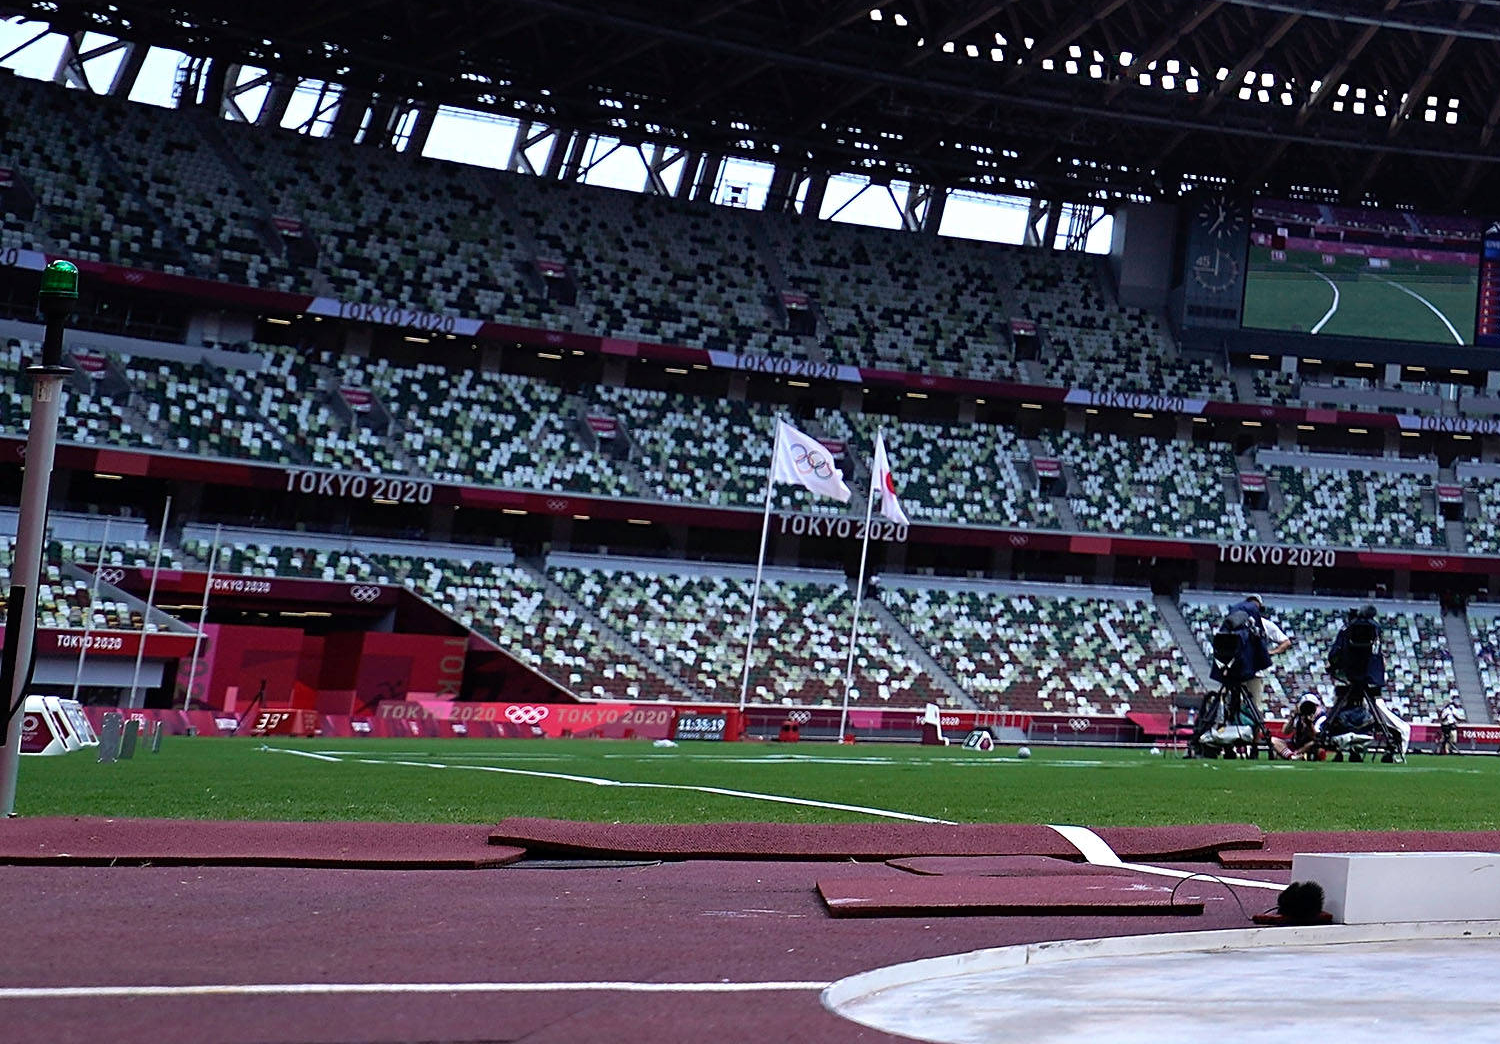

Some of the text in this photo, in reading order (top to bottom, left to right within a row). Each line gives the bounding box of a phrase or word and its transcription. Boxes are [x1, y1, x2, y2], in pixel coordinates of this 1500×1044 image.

[339, 301, 455, 334] TOKYO 2020
[735, 354, 839, 380] TOKYO 2020
[1089, 389, 1184, 413] TOKYO 2020
[1419, 415, 1467, 433] TOKYO
[285, 469, 433, 504] TOKYO 2020
[779, 513, 908, 542] TOKYO 2020
[1218, 543, 1336, 567] TOKYO 2020
[57, 634, 123, 650] TOKYO 2020
[381, 704, 497, 721] TOKYO 2020
[556, 708, 668, 725] TOKYO 2020
